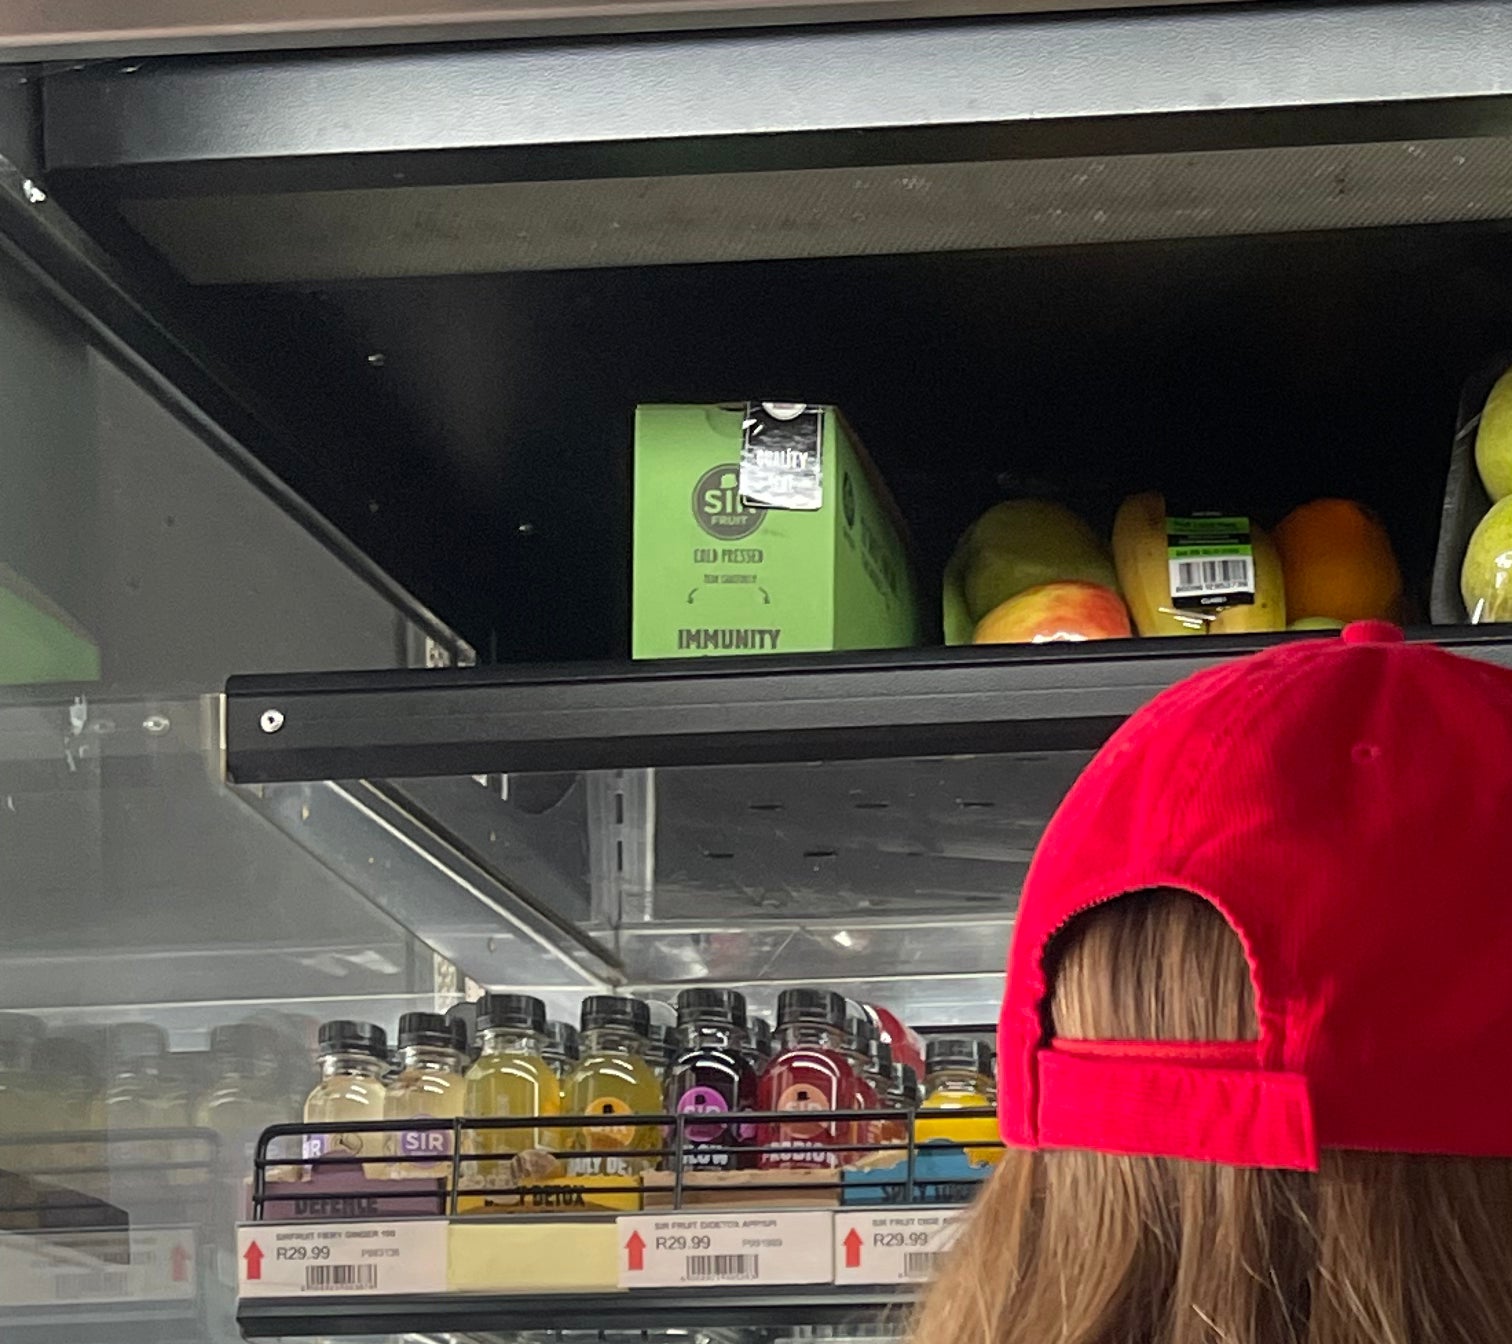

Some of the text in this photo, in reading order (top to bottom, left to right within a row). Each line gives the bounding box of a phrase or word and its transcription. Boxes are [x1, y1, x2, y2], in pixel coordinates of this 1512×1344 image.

[711, 514, 749, 527] FRUIT
[693, 548, 765, 564] COLD PRESSED
[678, 629, 781, 650] IMMUNITY
[405, 1132, 445, 1151] SIR
[656, 1235, 711, 1250] R29.99
[874, 1232, 928, 1248] R29.99
[276, 1245, 330, 1261] R29.99
